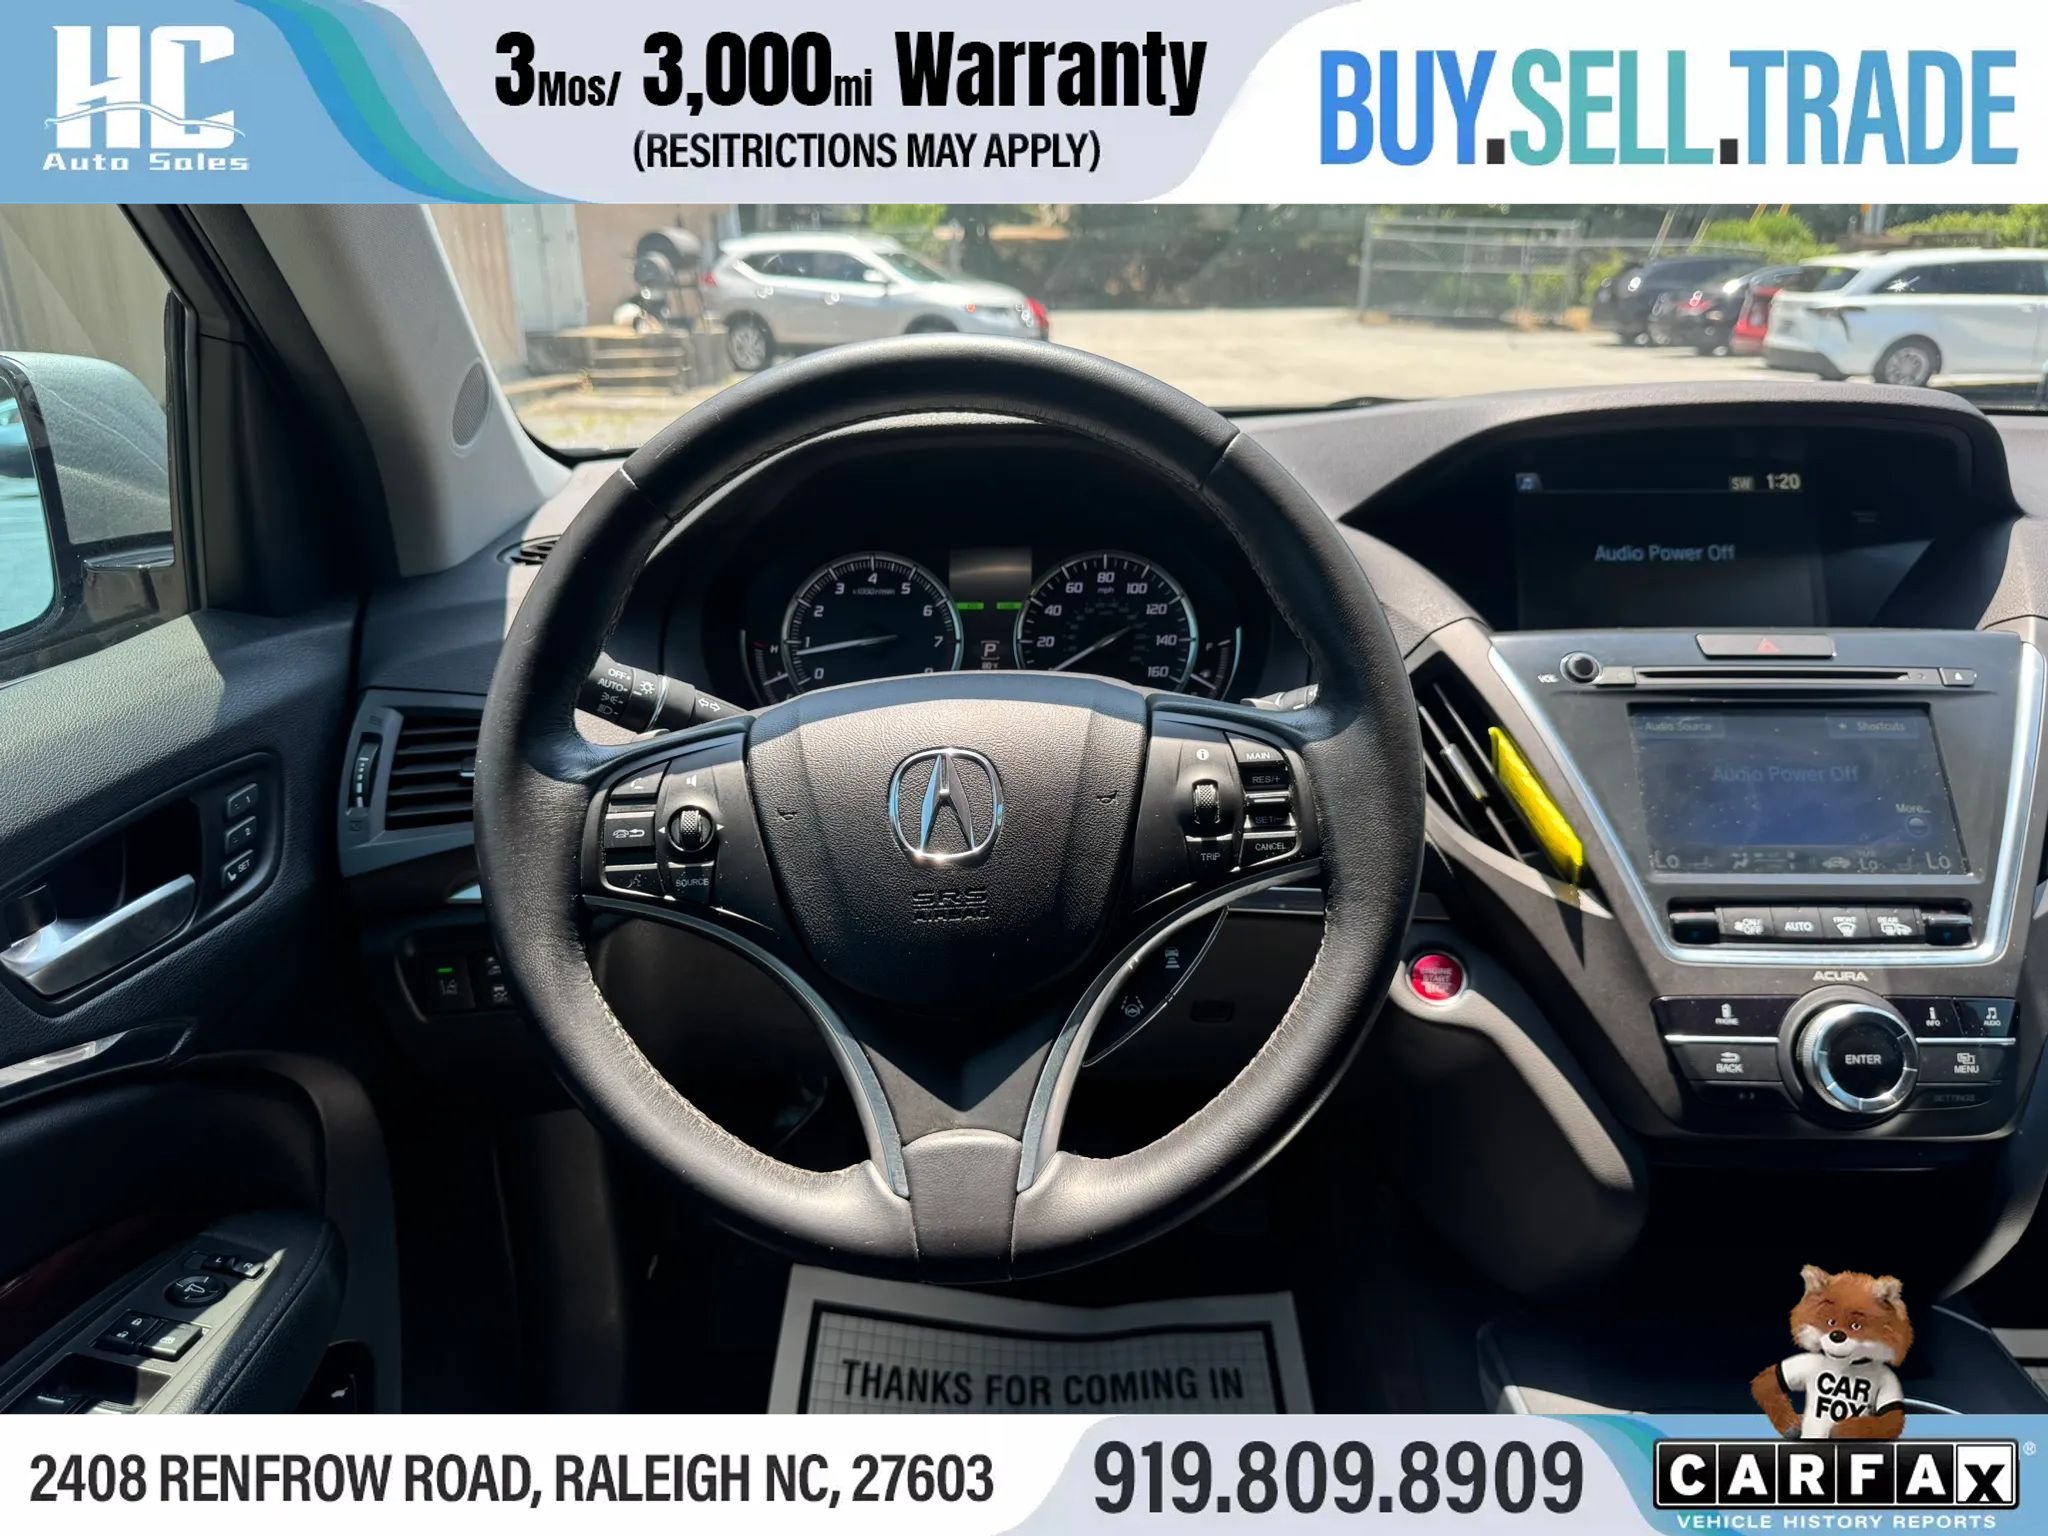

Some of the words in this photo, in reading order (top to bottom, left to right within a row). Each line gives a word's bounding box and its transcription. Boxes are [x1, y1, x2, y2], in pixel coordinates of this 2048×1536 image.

[1766, 473, 1800, 491] 1:20
[1594, 545, 1644, 562] Audio
[1649, 545, 1703, 562] Power
[1707, 544, 1736, 562] Off
[867, 573, 878, 585] 4
[1097, 572, 1115, 583] 80
[835, 582, 845, 595] 3
[900, 582, 911, 595] 5
[1065, 582, 1084, 594] 60
[1126, 583, 1148, 595] 100
[813, 605, 824, 617] 2
[922, 605, 933, 617] 6
[1044, 605, 1062, 616] 40
[1146, 604, 1168, 615] 120
[934, 636, 944, 648] 7
[1036, 636, 1055, 647] 20
[1156, 634, 1178, 646] 140
[983, 643, 997, 657] P
[608, 668, 627, 681] OFF
[813, 667, 825, 680] 0
[1148, 666, 1169, 678] 160
[598, 677, 623, 692] AUTO
[1246, 752, 1271, 760] MAIN
[1712, 766, 1762, 783] Audio
[1769, 766, 1825, 783] Power
[1830, 765, 1859, 783] Off
[1255, 842, 1287, 852] CANCEL
[1200, 853, 1221, 862] TRIP
[675, 877, 709, 888] SOURCE
[1784, 920, 1813, 933] AUTO
[1813, 971, 1868, 982] ACURA
[1844, 1054, 1882, 1065] ENTER
[1716, 1063, 1743, 1073] BACK
[1954, 1065, 1980, 1074] MENU
[842, 1359, 973, 1403] THANKS
[985, 1373, 1052, 1407] FOR
[1063, 1366, 1198, 1405] COMING
[1211, 1367, 1244, 1400] IN
